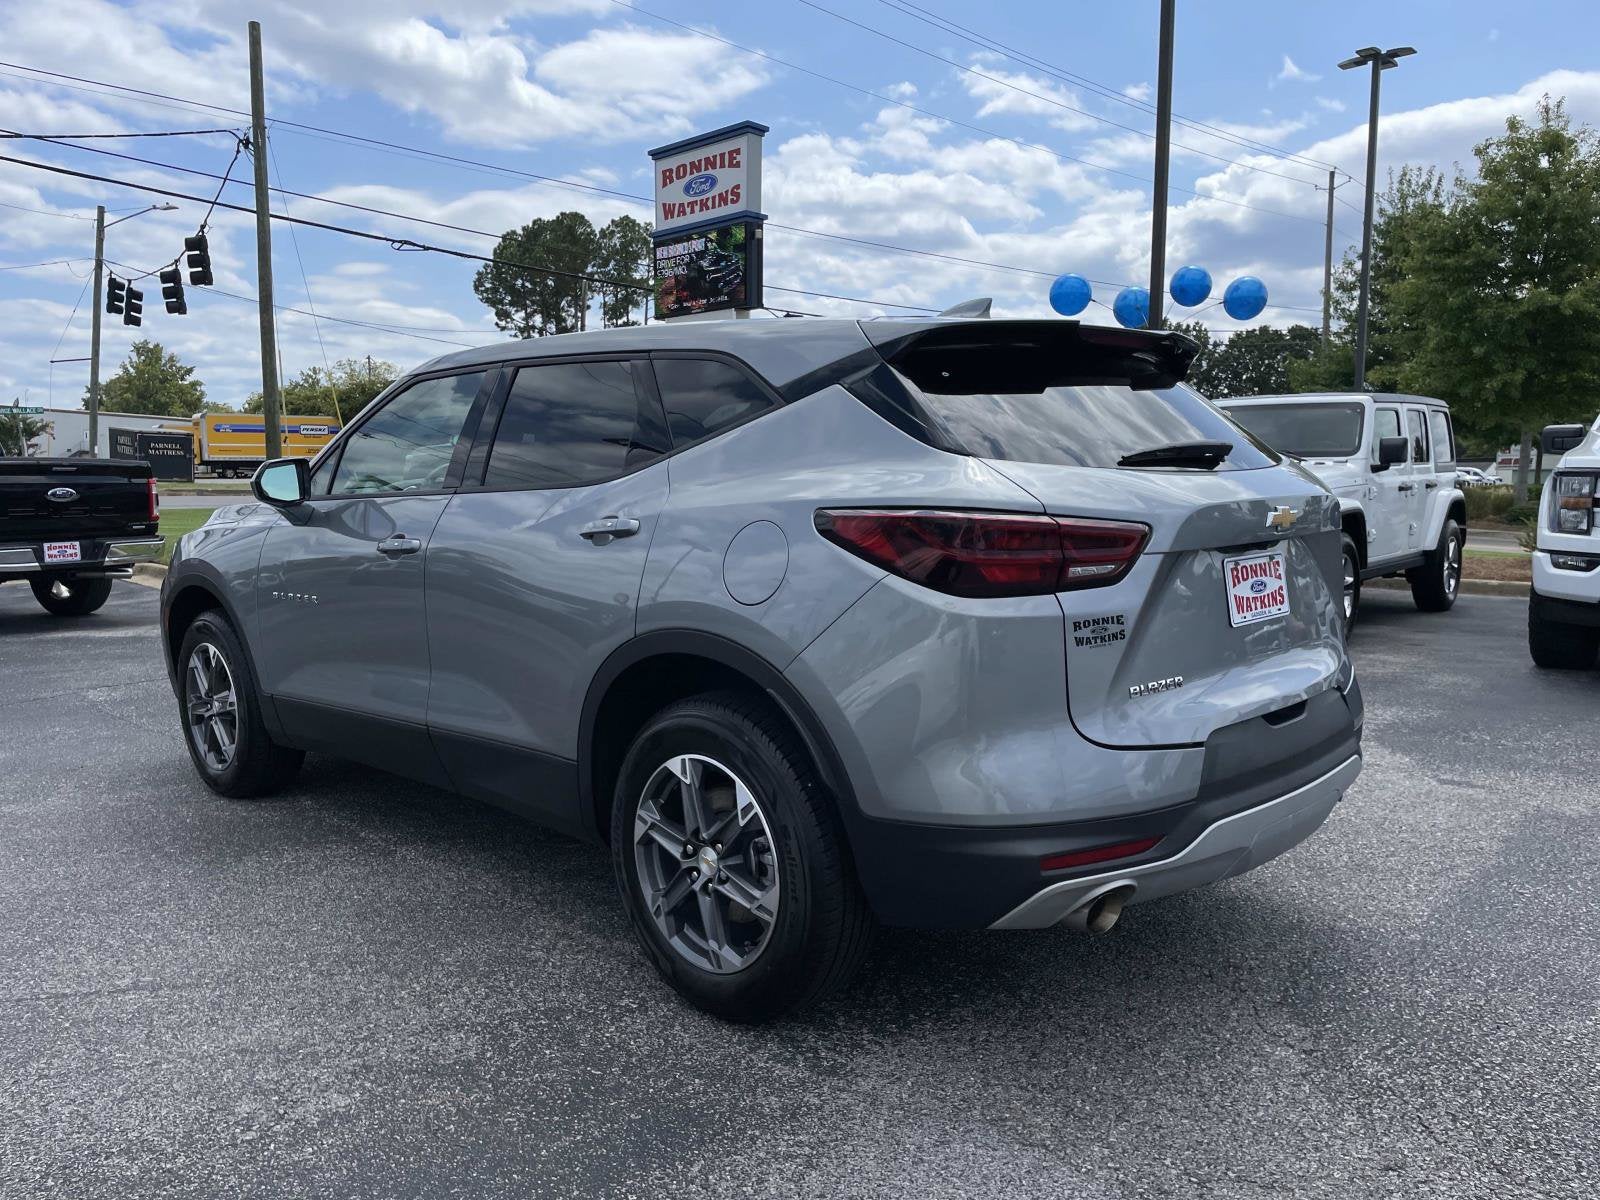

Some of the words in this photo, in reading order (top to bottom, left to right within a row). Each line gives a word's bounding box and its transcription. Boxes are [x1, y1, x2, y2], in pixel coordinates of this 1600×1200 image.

[662, 148, 741, 189] RONNIE
[689, 178, 712, 195] Ford
[662, 184, 741, 220] WATKINS
[1230, 560, 1282, 589] RONNIE
[272, 591, 319, 604] BLAZER
[1252, 580, 1265, 593] Ford
[1233, 585, 1285, 614] WATKINS
[1073, 614, 1125, 633] RONNIE
[1074, 629, 1126, 647] WATKINS
[1128, 675, 1184, 700] BLAZER
